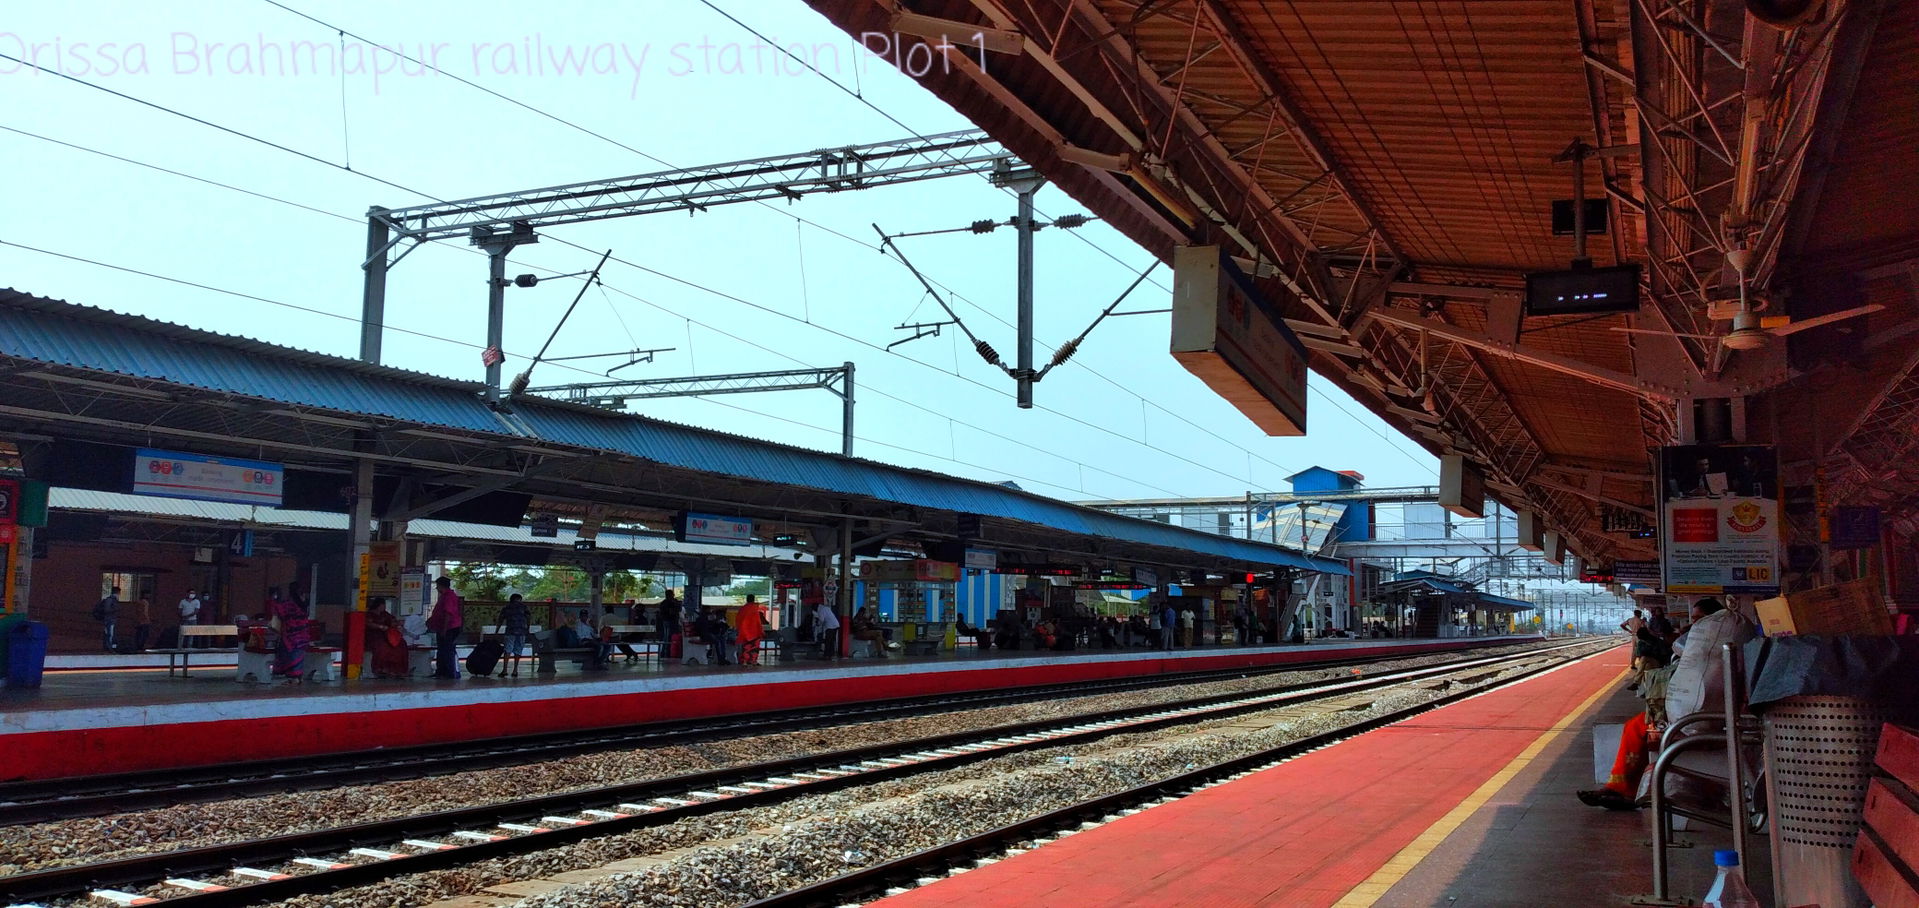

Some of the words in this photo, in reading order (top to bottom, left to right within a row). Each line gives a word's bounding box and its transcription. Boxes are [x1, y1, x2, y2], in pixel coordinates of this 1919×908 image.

[231, 532, 242, 554] 4
[1280, 571, 1287, 580] 2
[1748, 567, 1769, 580] LIC
